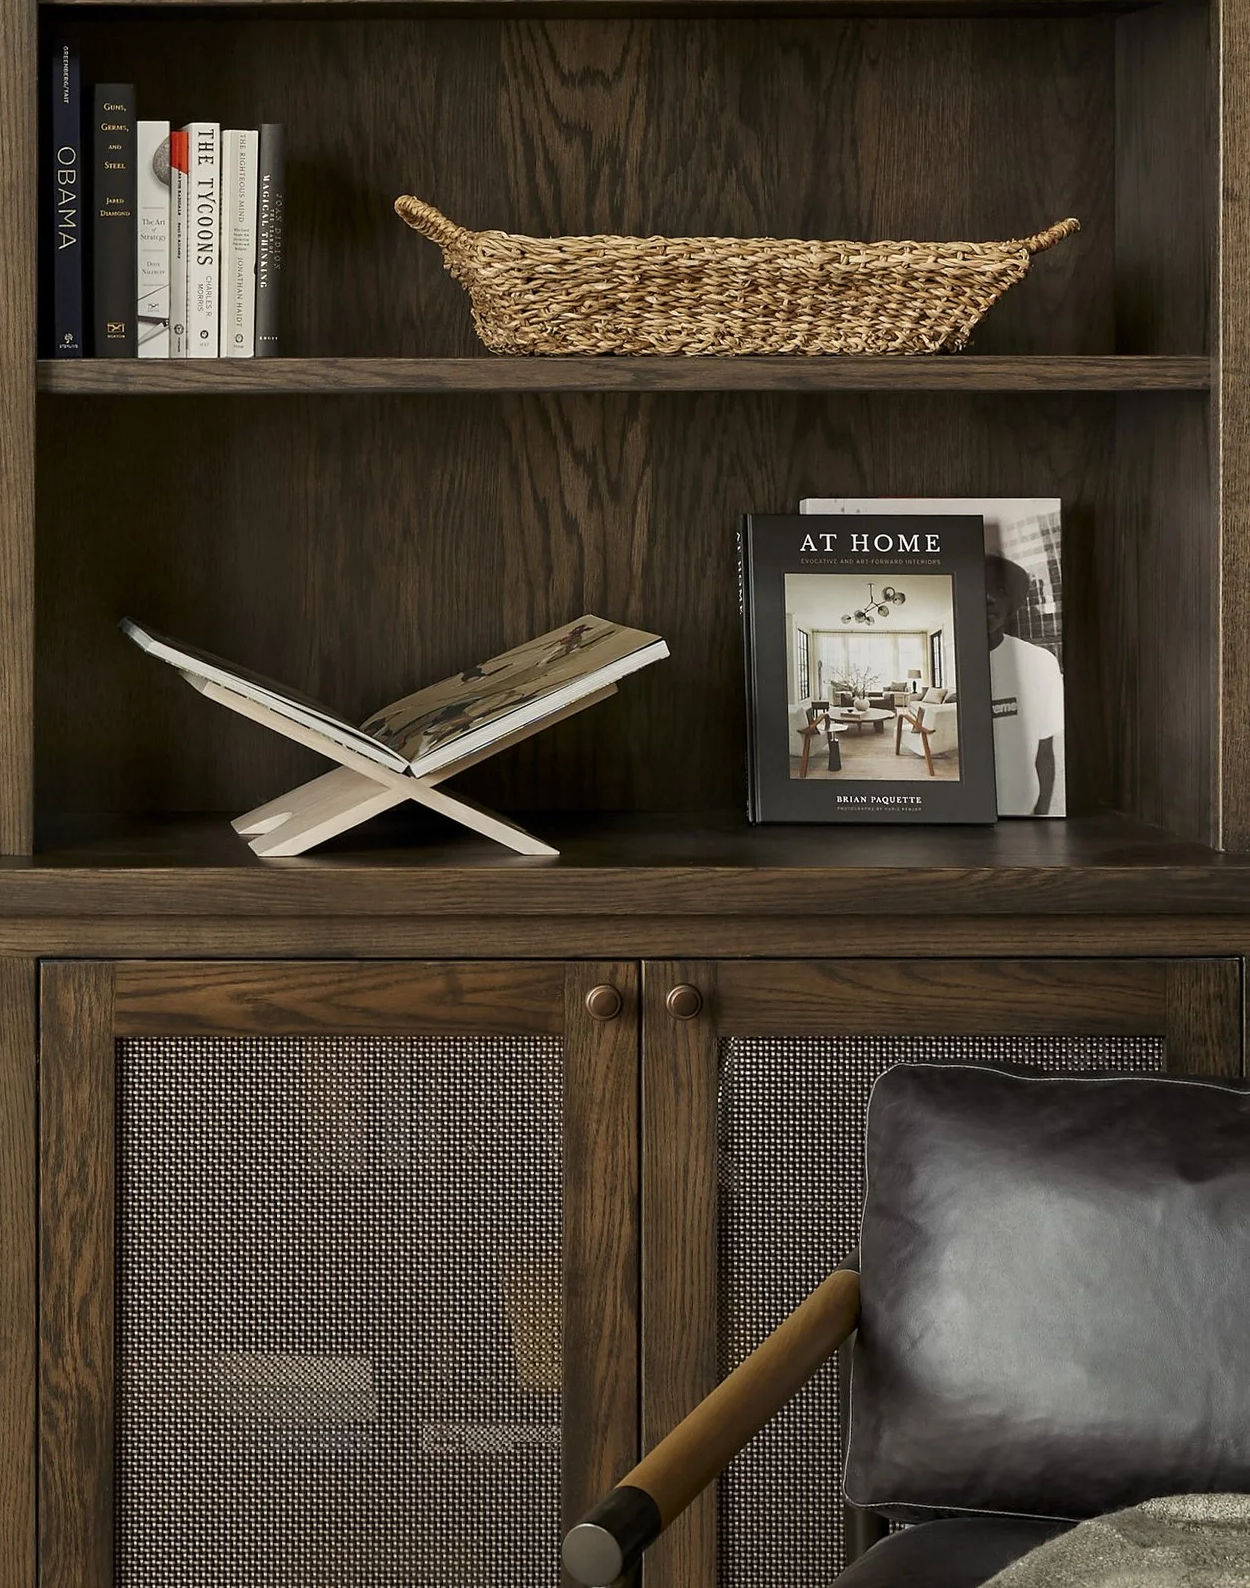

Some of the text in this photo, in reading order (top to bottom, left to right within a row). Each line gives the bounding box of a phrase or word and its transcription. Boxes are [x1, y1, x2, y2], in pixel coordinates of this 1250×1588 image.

[55, 145, 78, 251] OBAMA
[196, 128, 217, 267] THE TYCOONS
[141, 217, 166, 227] The Art
[140, 232, 167, 243] Strategy
[798, 532, 942, 554] AT HOME
[835, 794, 923, 806] BRIAN PAQUETTE
